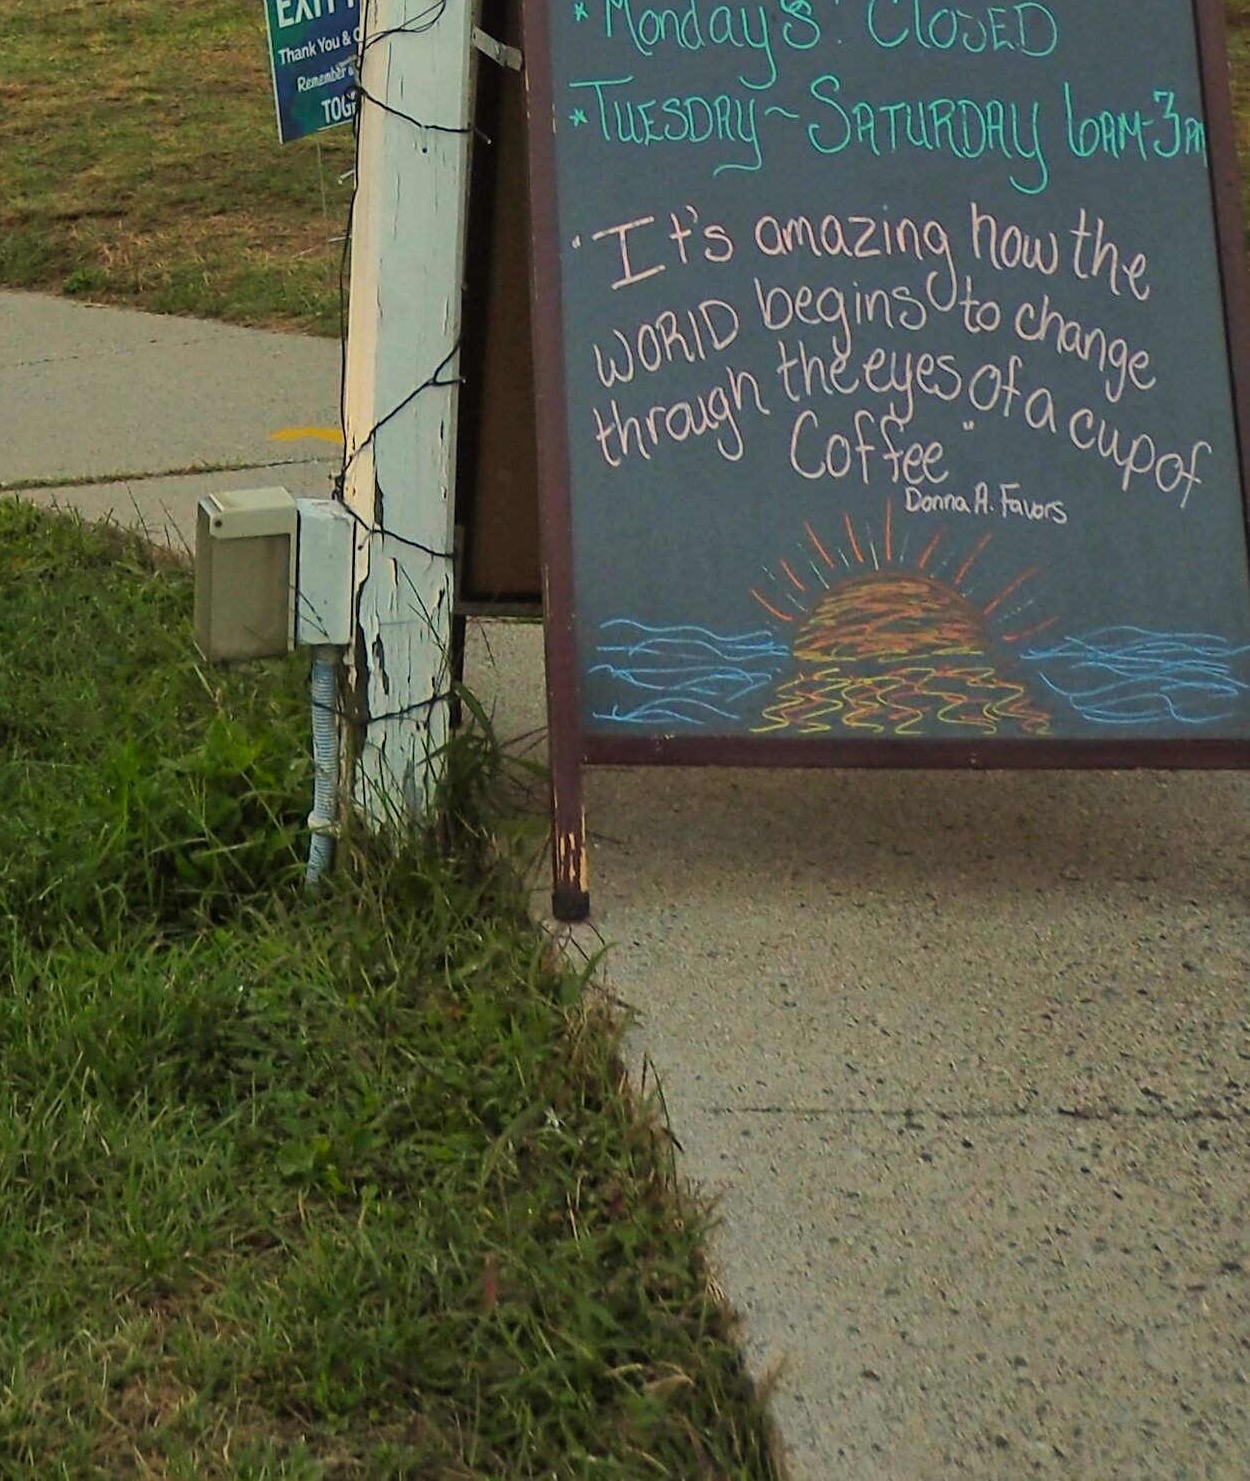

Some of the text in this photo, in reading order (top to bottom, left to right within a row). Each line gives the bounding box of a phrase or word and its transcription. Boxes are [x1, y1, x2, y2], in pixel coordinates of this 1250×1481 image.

[278, 41, 317, 66] Thank
[317, 35, 340, 53] You
[342, 30, 352, 45] &
[297, 65, 348, 93] Remember
[754, 203, 957, 312] amazing
[970, 201, 1059, 274] how
[1069, 207, 1150, 301] the
[754, 277, 928, 360] begins
[958, 275, 1002, 333] to
[1014, 293, 1157, 404] change
[593, 365, 771, 468] through
[776, 340, 860, 402] the
[862, 348, 962, 426] eyes
[1024, 387, 1057, 434] a
[1069, 407, 1156, 492] cup
[1154, 440, 1213, 509] of
[904, 485, 972, 513] Donna
[999, 482, 1069, 525] Favors
